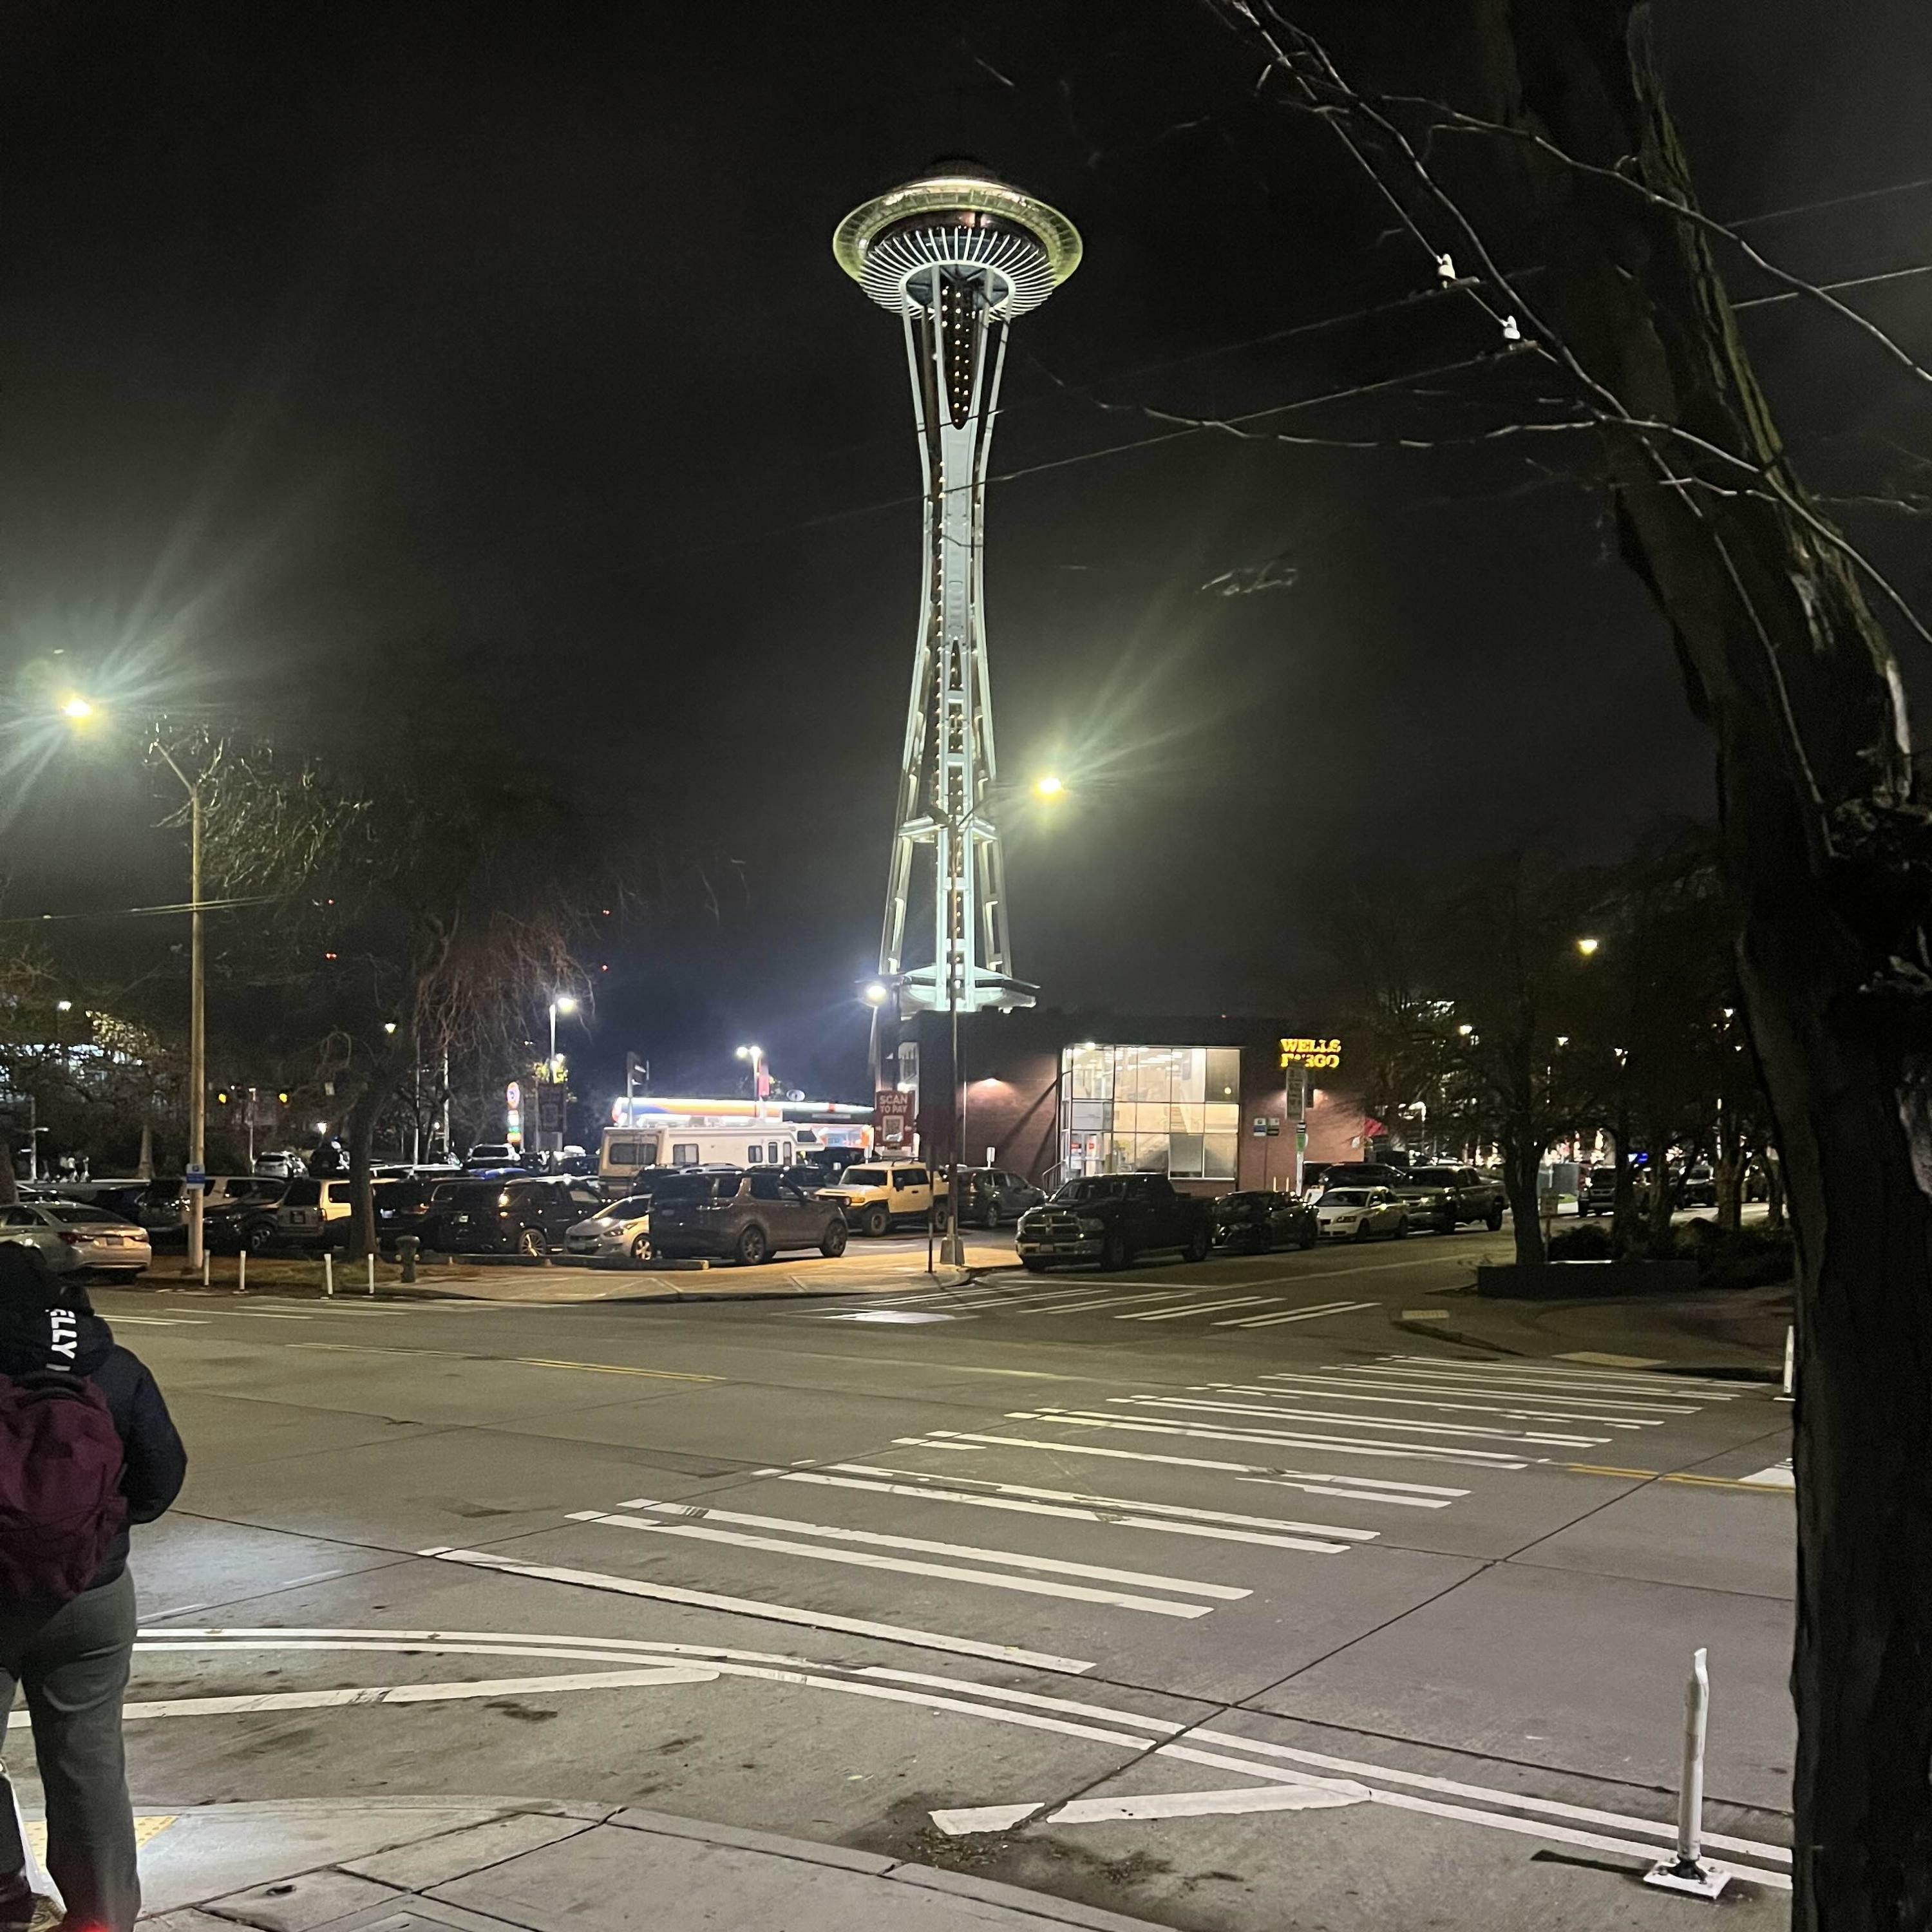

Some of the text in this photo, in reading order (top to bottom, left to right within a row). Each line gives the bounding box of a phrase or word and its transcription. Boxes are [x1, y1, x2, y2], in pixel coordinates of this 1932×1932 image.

[1280, 1039, 1341, 1052] WELLS
[880, 1095, 908, 1104] SCAN
[880, 1104, 908, 1113] TO PAY
